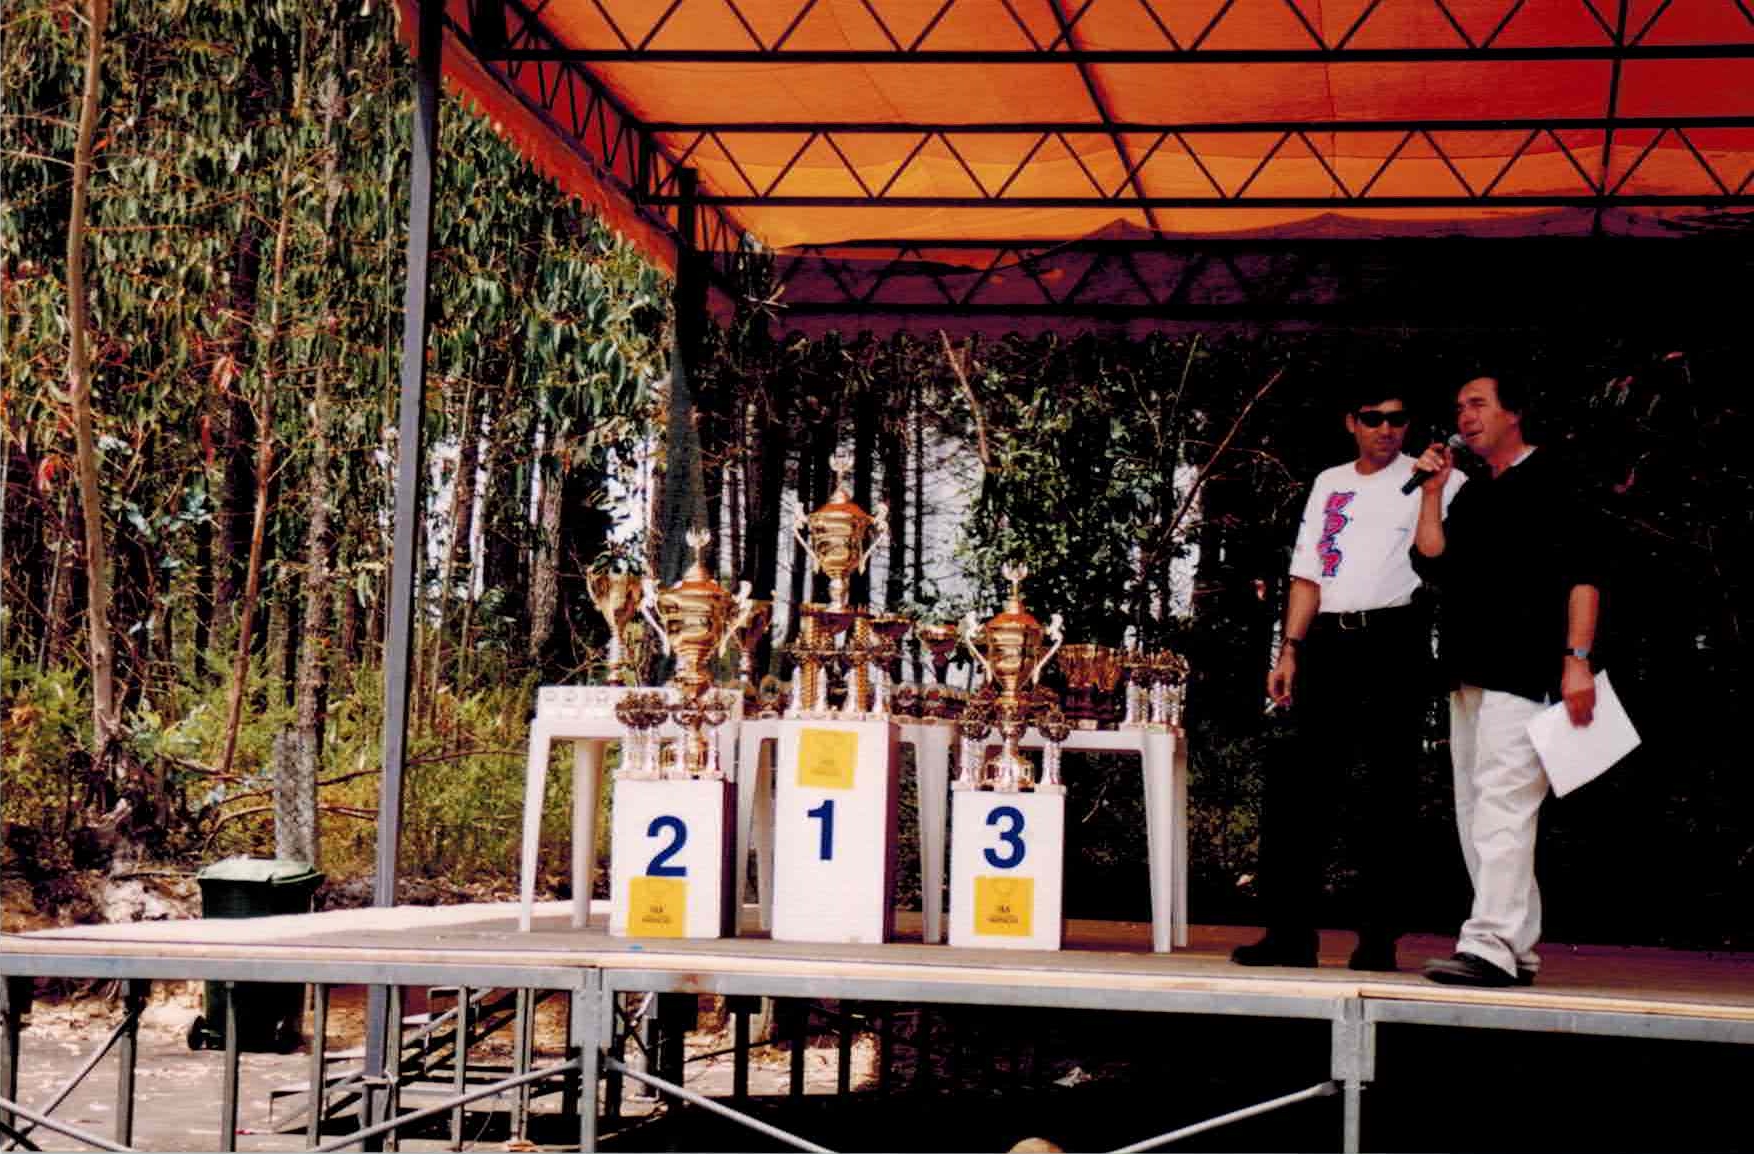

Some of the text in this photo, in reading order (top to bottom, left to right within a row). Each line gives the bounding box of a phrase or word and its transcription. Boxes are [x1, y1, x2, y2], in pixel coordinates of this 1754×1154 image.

[646, 815, 688, 877] 2
[807, 799, 835, 861] 1
[983, 805, 1027, 870] 3
